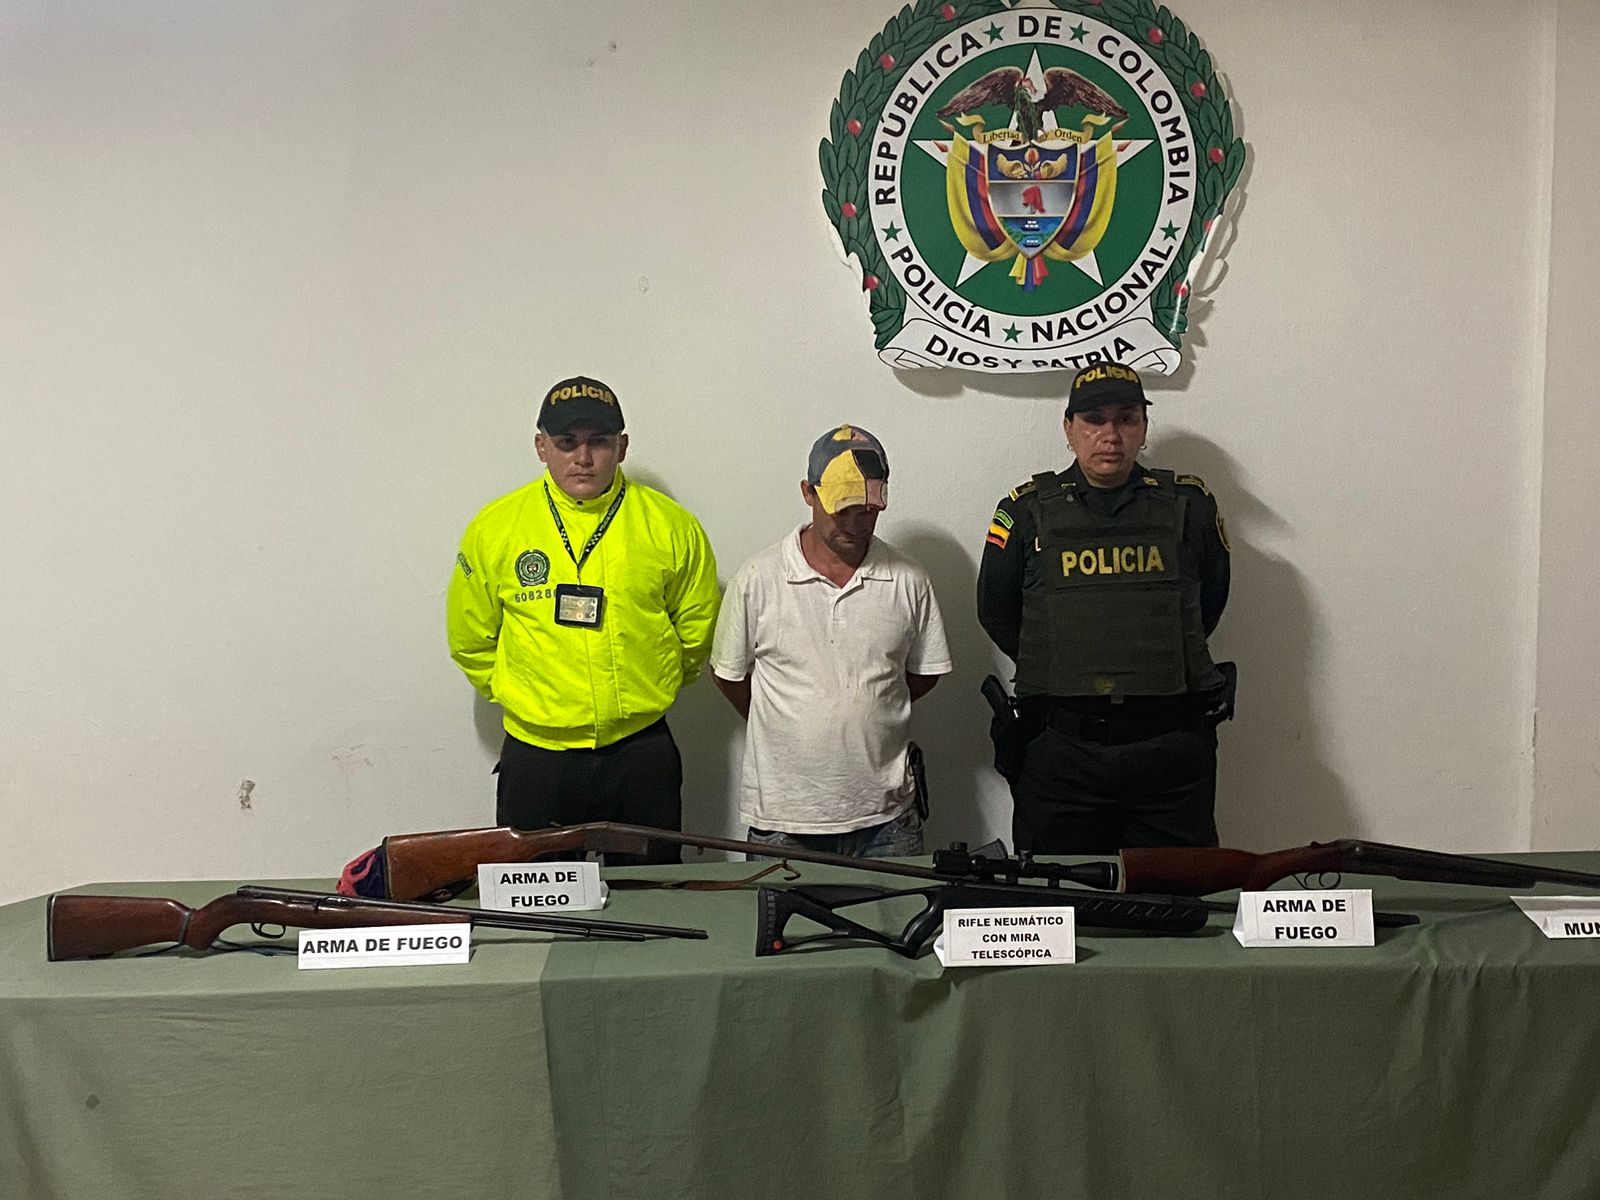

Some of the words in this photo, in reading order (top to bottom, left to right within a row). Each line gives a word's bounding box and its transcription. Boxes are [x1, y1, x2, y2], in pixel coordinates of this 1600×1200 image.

[874, 31, 983, 206] REPÚBLICA
[1018, 16, 1062, 38] DE
[1098, 34, 1190, 206] COLOMBIA
[983, 130, 1020, 142] Libertad
[1054, 129, 1083, 142] Orden
[890, 246, 991, 339] POLICÍA
[1031, 247, 1174, 343] NACIONAL
[1075, 365, 1140, 389] POLICIA
[550, 384, 615, 406] POLICIA
[1061, 546, 1165, 577] POLICIA
[514, 588, 556, 603] 60828
[500, 872, 549, 885] ARMA
[554, 871, 578, 883] DE
[511, 894, 570, 907] FUEGO
[1262, 900, 1317, 913] ARMA
[1322, 899, 1347, 912] DE
[957, 918, 991, 928] RIFLE
[994, 915, 1064, 927] NEUMÁTICO
[982, 934, 1007, 943] CON
[1010, 933, 1041, 942] MIRA
[1274, 927, 1338, 940] FUEGO
[302, 939, 359, 954] ARMA
[365, 938, 391, 951] DE
[396, 936, 463, 951] FUEGO
[971, 948, 1052, 960] TELESCÓPICA
